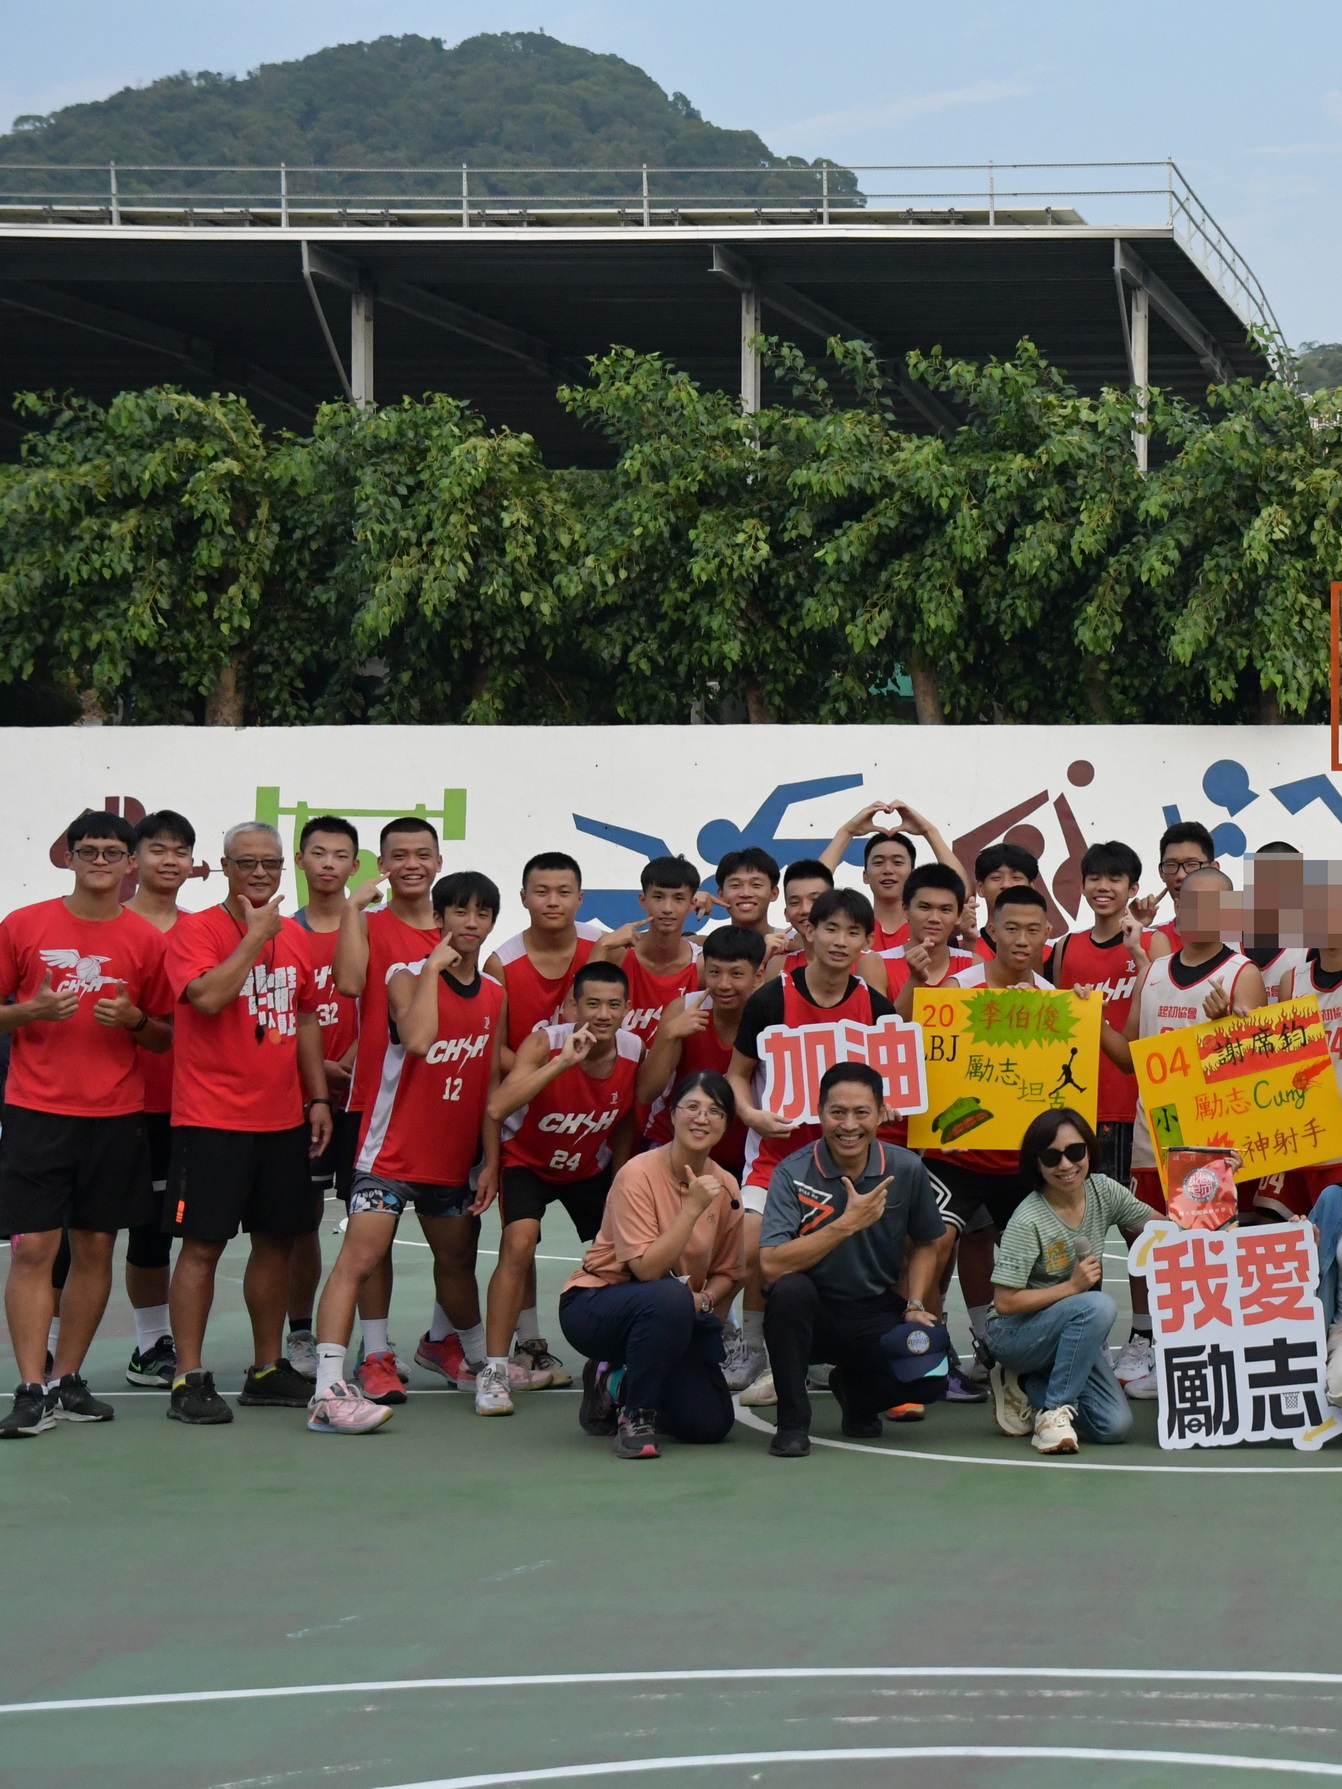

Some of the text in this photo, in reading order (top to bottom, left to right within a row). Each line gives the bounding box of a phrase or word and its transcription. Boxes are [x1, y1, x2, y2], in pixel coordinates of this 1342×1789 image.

[316, 1002, 339, 1026] 32
[922, 1003, 954, 1028] 20
[978, 1000, 1061, 1034] 李伯俊
[1157, 1005, 1198, 1020] 起初協會
[925, 1035, 959, 1062] BJ
[765, 1022, 921, 1119] 加油
[1146, 1046, 1191, 1085] 04
[442, 1077, 463, 1101] 12
[1195, 1087, 1251, 1122] 勵志
[1156, 1107, 1179, 1133] 小
[1244, 1117, 1326, 1163] 神射手
[549, 1149, 582, 1172] 24
[1258, 1172, 1286, 1195] 04
[1153, 1229, 1315, 1334] 我愛
[1163, 1337, 1323, 1440] 勵志
